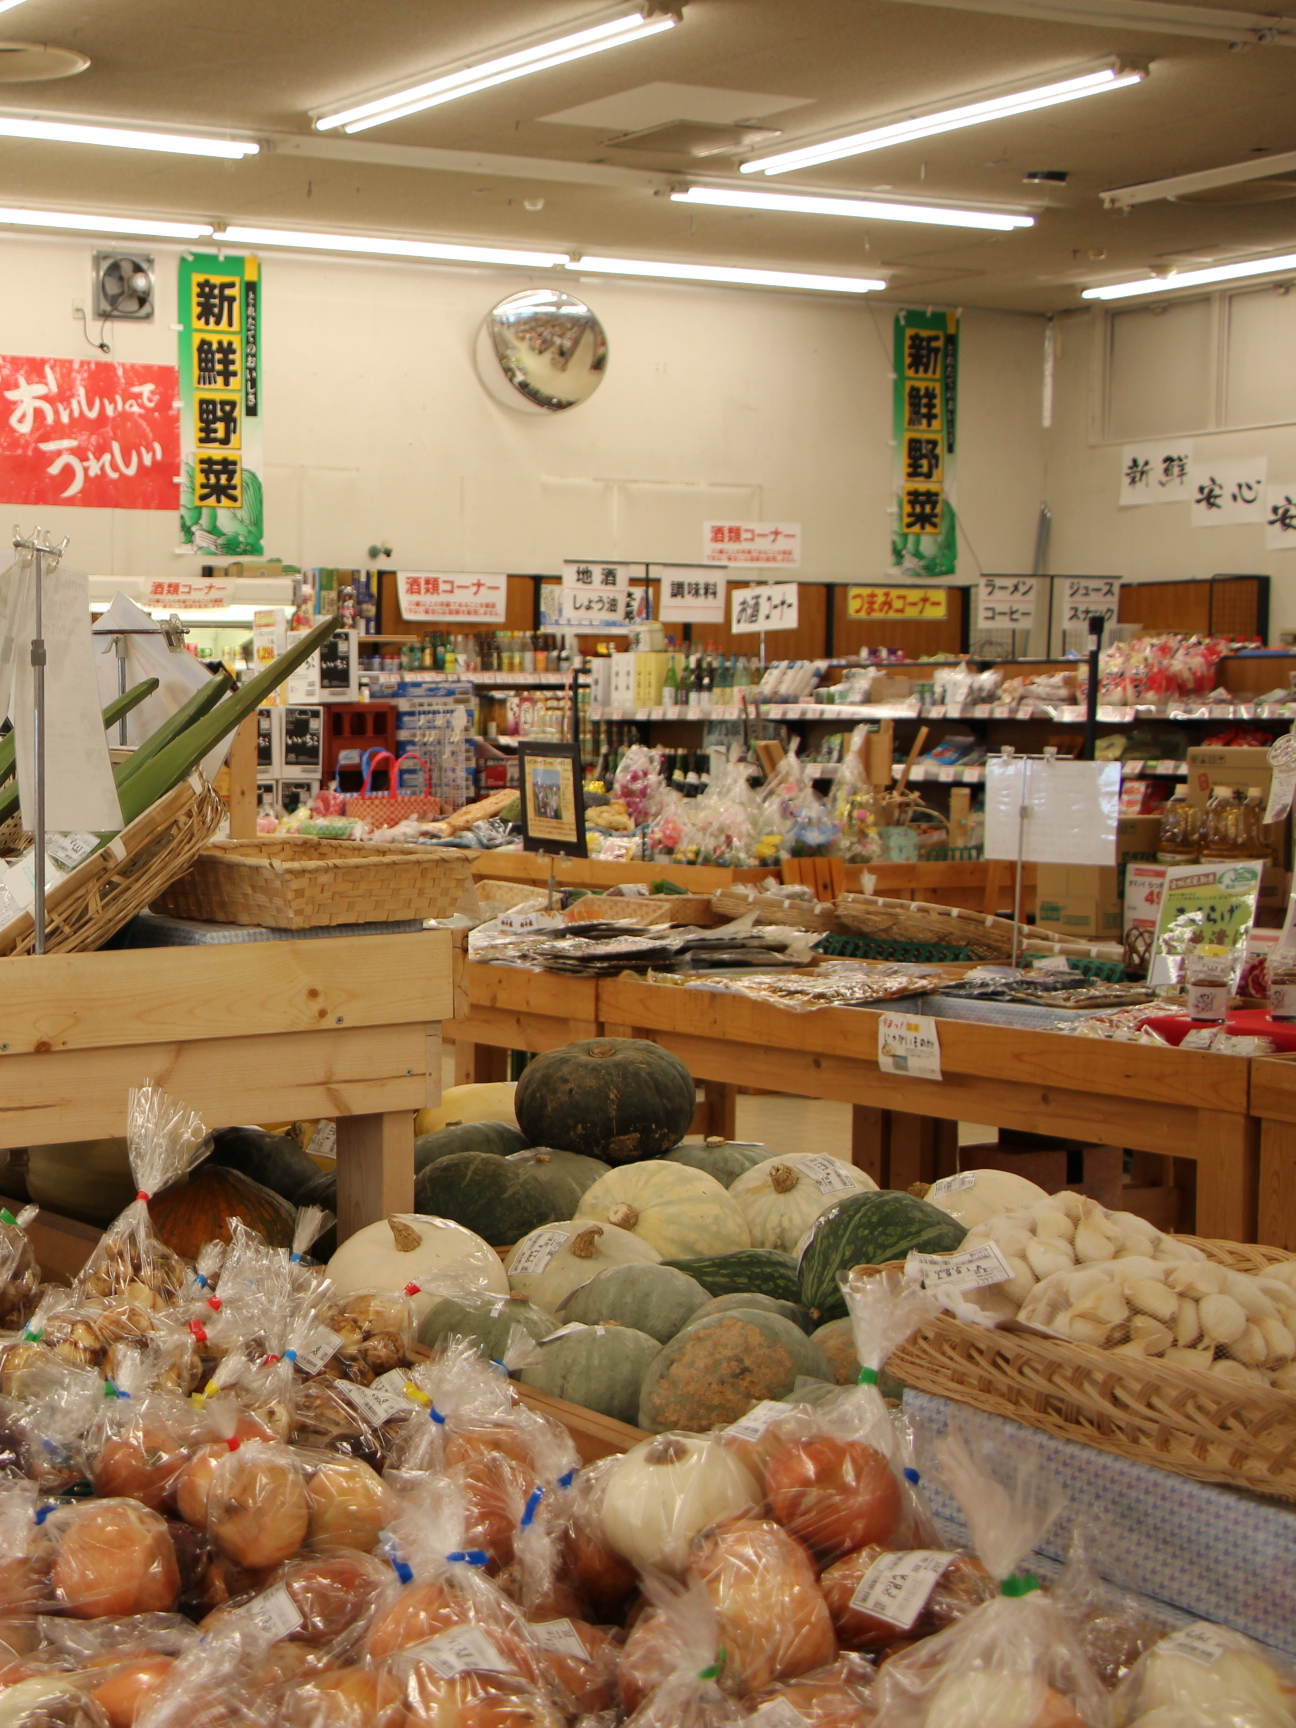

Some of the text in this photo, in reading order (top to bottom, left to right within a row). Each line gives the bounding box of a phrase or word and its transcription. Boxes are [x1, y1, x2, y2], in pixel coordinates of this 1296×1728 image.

[245, 290, 256, 407] とれたてのおいしさ
[195, 278, 239, 504] 新鮮野菜
[906, 331, 942, 531] 新鮮野菜
[37, 438, 163, 498] うれしい
[1124, 454, 1189, 488] 新鮮
[1195, 477, 1263, 510] 安心
[709, 525, 797, 544] 酒類コーナー
[405, 576, 501, 596] 酒類コーナー
[575, 565, 619, 587] 地酒
[150, 581, 227, 596] 酒類コーナー
[669, 580, 718, 600] 調味料
[982, 578, 1035, 598] ラーメン
[1067, 579, 1116, 598] ジュース
[572, 593, 619, 613] しょう油
[851, 592, 942, 616] つまみコーナー
[983, 607, 1033, 623] コーヒー
[1067, 606, 1115, 623] スナック
